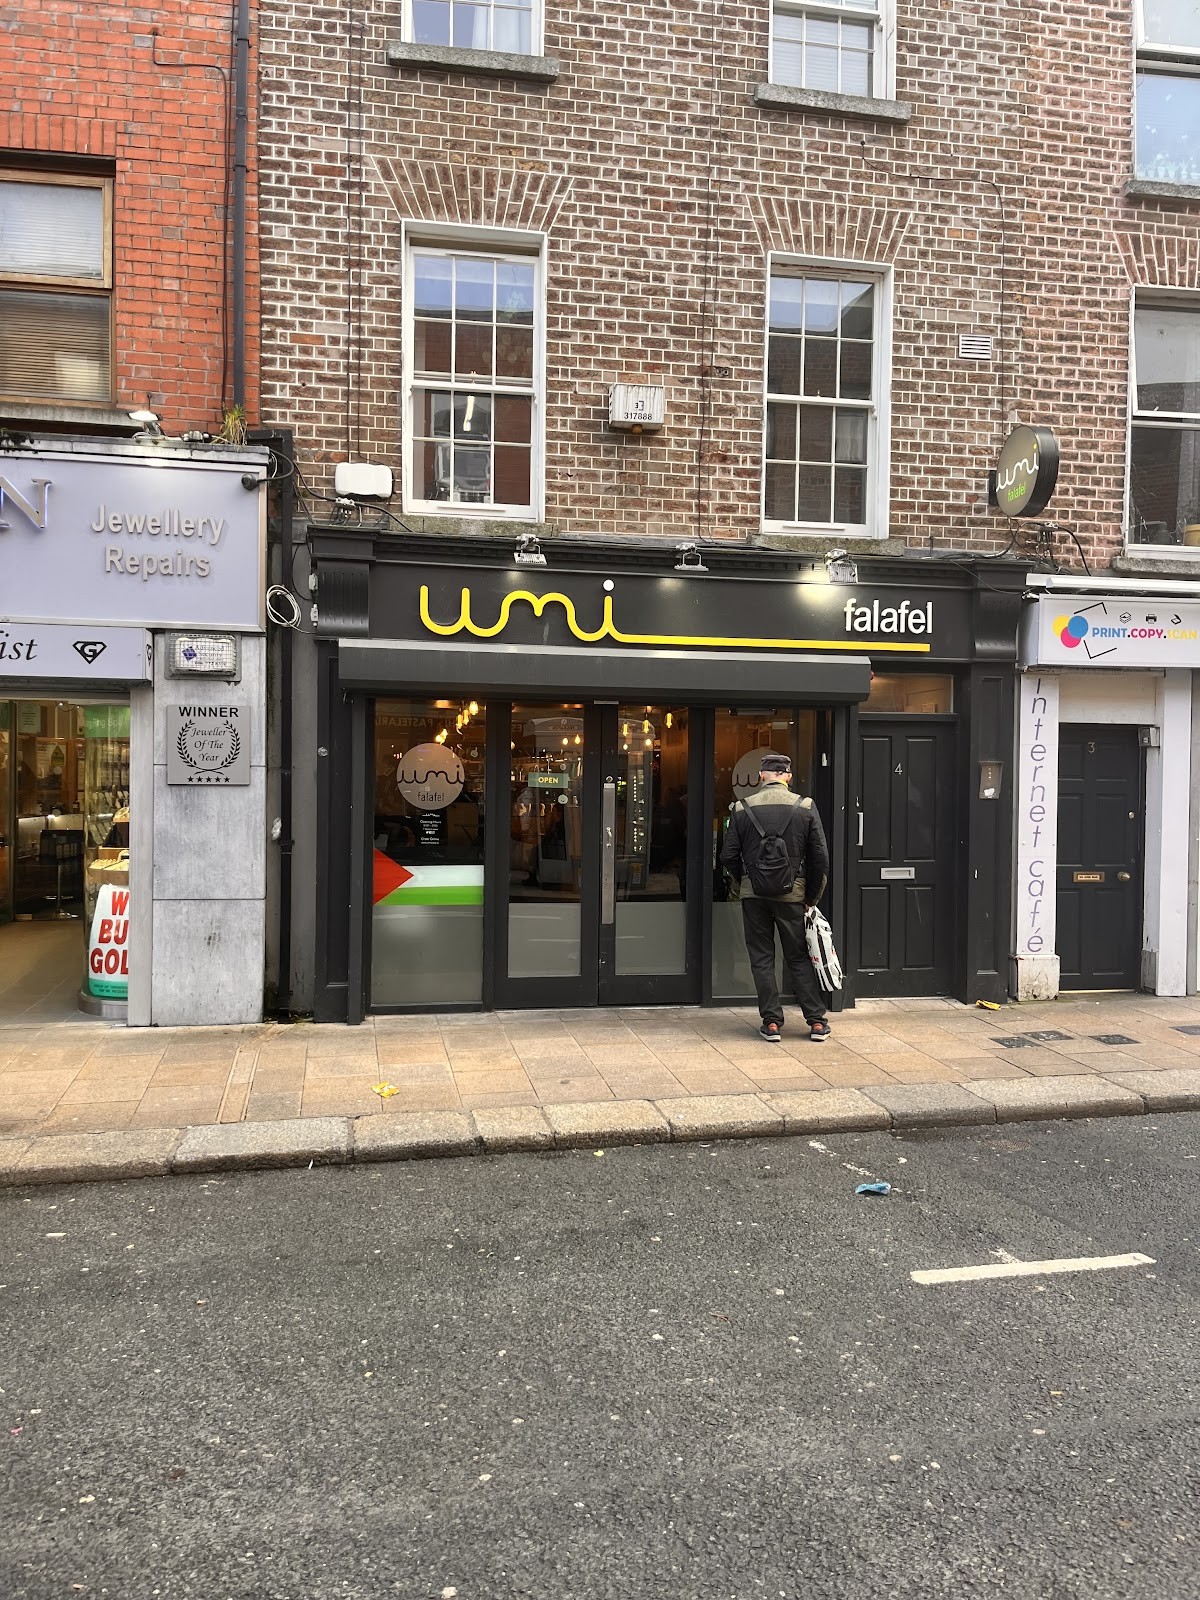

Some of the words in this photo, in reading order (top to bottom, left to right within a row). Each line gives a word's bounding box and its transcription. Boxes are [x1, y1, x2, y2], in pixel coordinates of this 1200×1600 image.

[994, 443, 1039, 493] umi
[1007, 482, 1026, 502] falafel
[91, 503, 225, 546] Jewellery
[105, 544, 211, 581] Repairs
[419, 579, 622, 643] umi
[843, 597, 933, 634] falafel
[0, 629, 38, 661] ist
[178, 706, 239, 718] WINNER
[190, 727, 227, 737] Jeweller
[194, 740, 208, 751] Of
[208, 740, 224, 749] The
[1087, 741, 1095, 753] 3
[199, 753, 220, 761] Year
[397, 765, 465, 784] umi
[894, 762, 903, 775] 4
[538, 776, 559, 784] OPEN
[417, 792, 445, 802] falafel
[111, 891, 130, 916] W
[1027, 860, 1045, 953] café
[98, 918, 130, 945] BU
[90, 947, 129, 975] GOL
